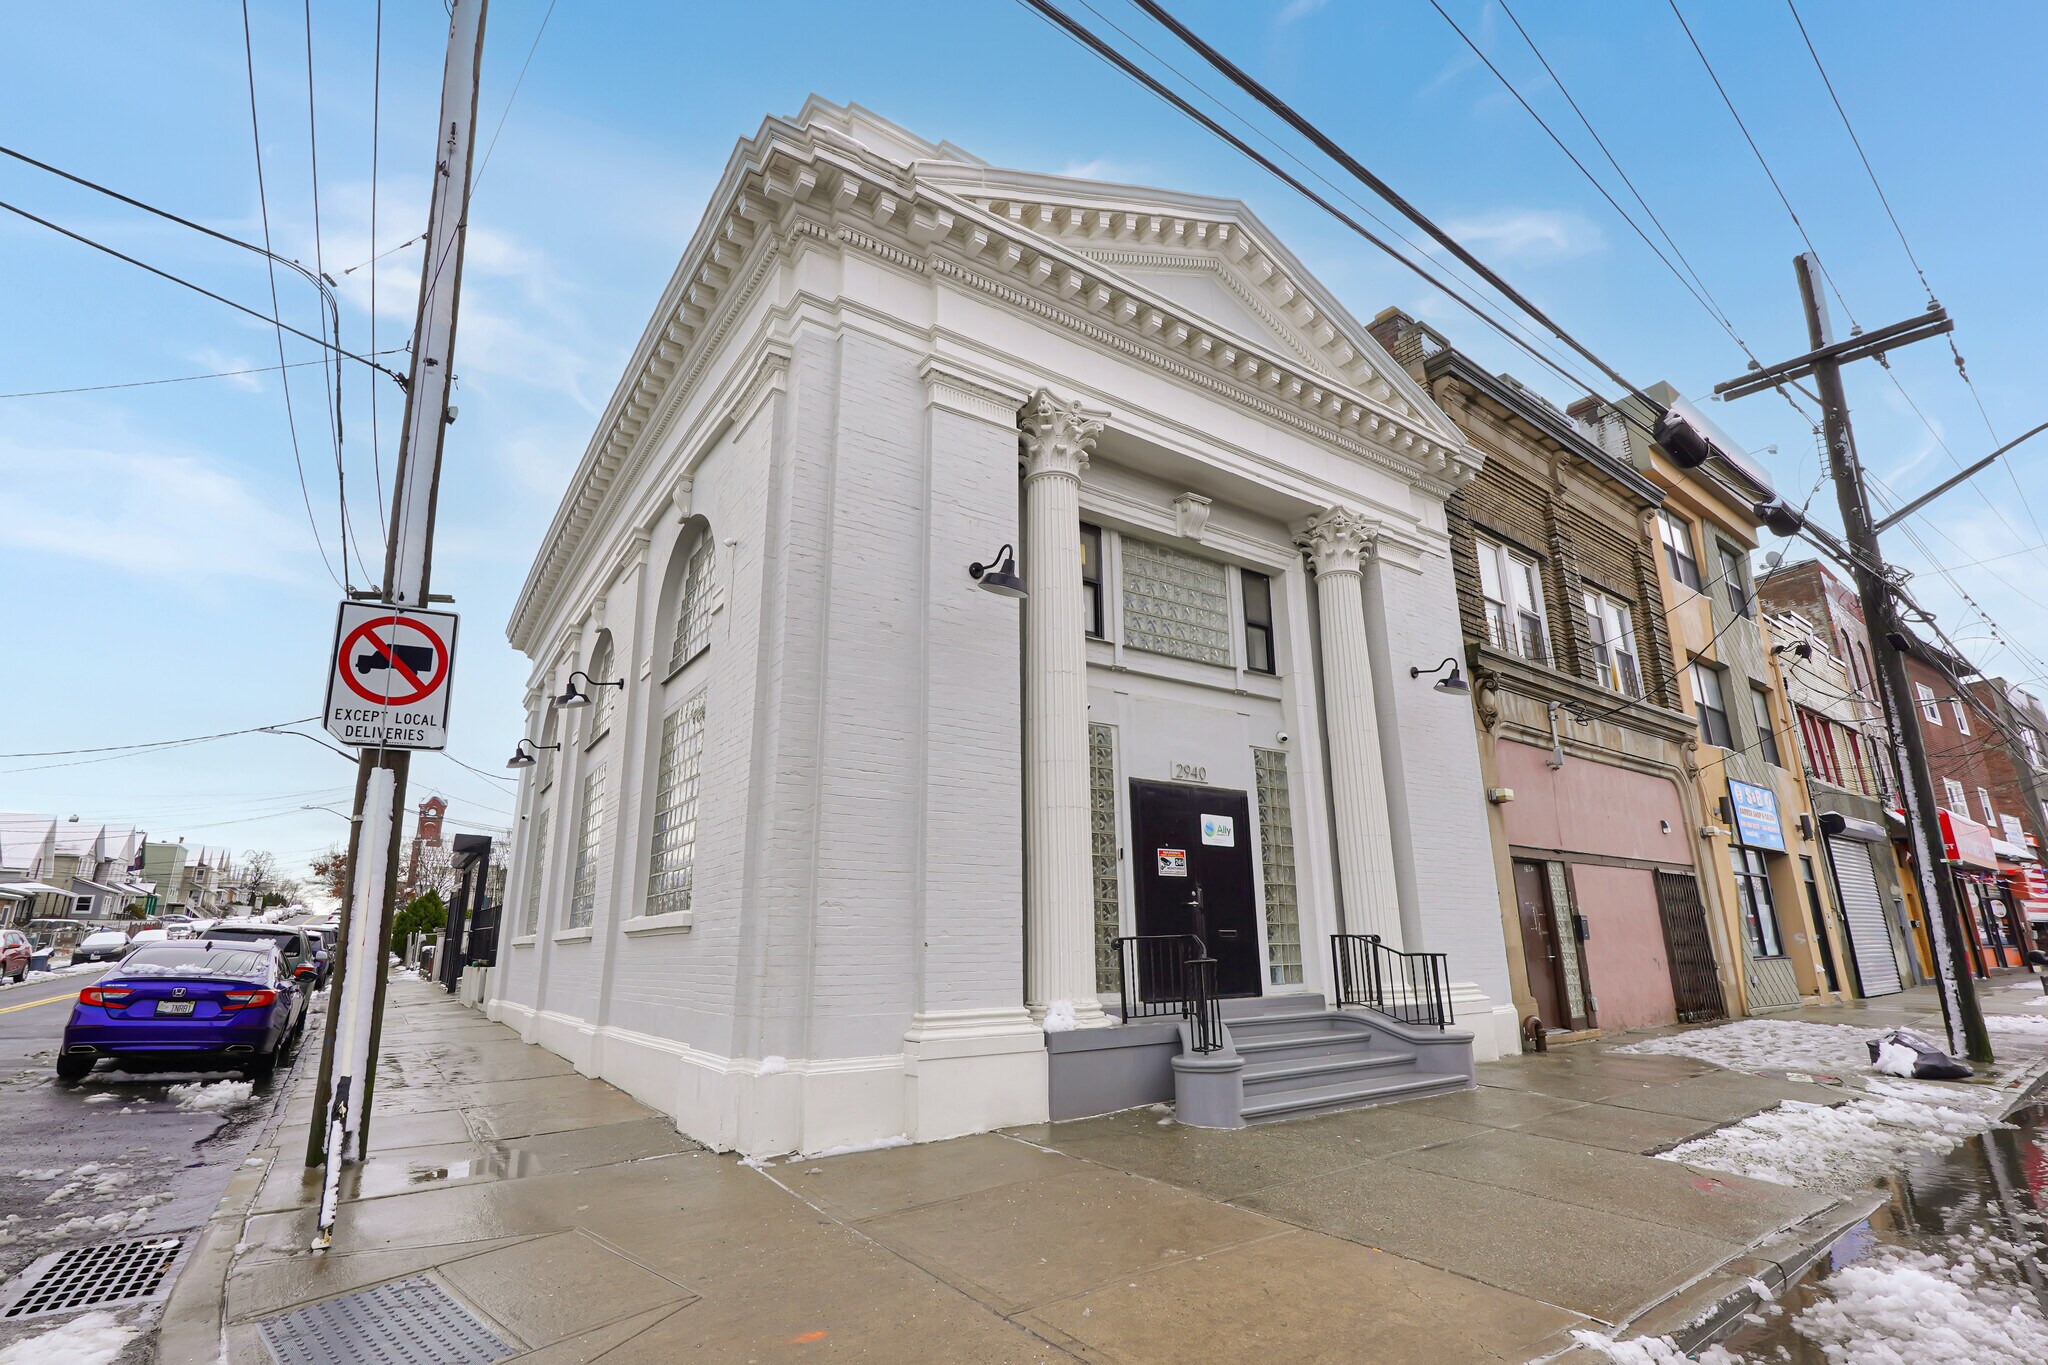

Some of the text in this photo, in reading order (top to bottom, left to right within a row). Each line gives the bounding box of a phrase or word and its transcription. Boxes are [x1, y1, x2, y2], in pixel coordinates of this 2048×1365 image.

[335, 708, 437, 726] EXCEPT LOCAL
[345, 725, 425, 741] DELIVERIES
[1176, 763, 1207, 781] 2940
[1217, 825, 1232, 836] Ally
